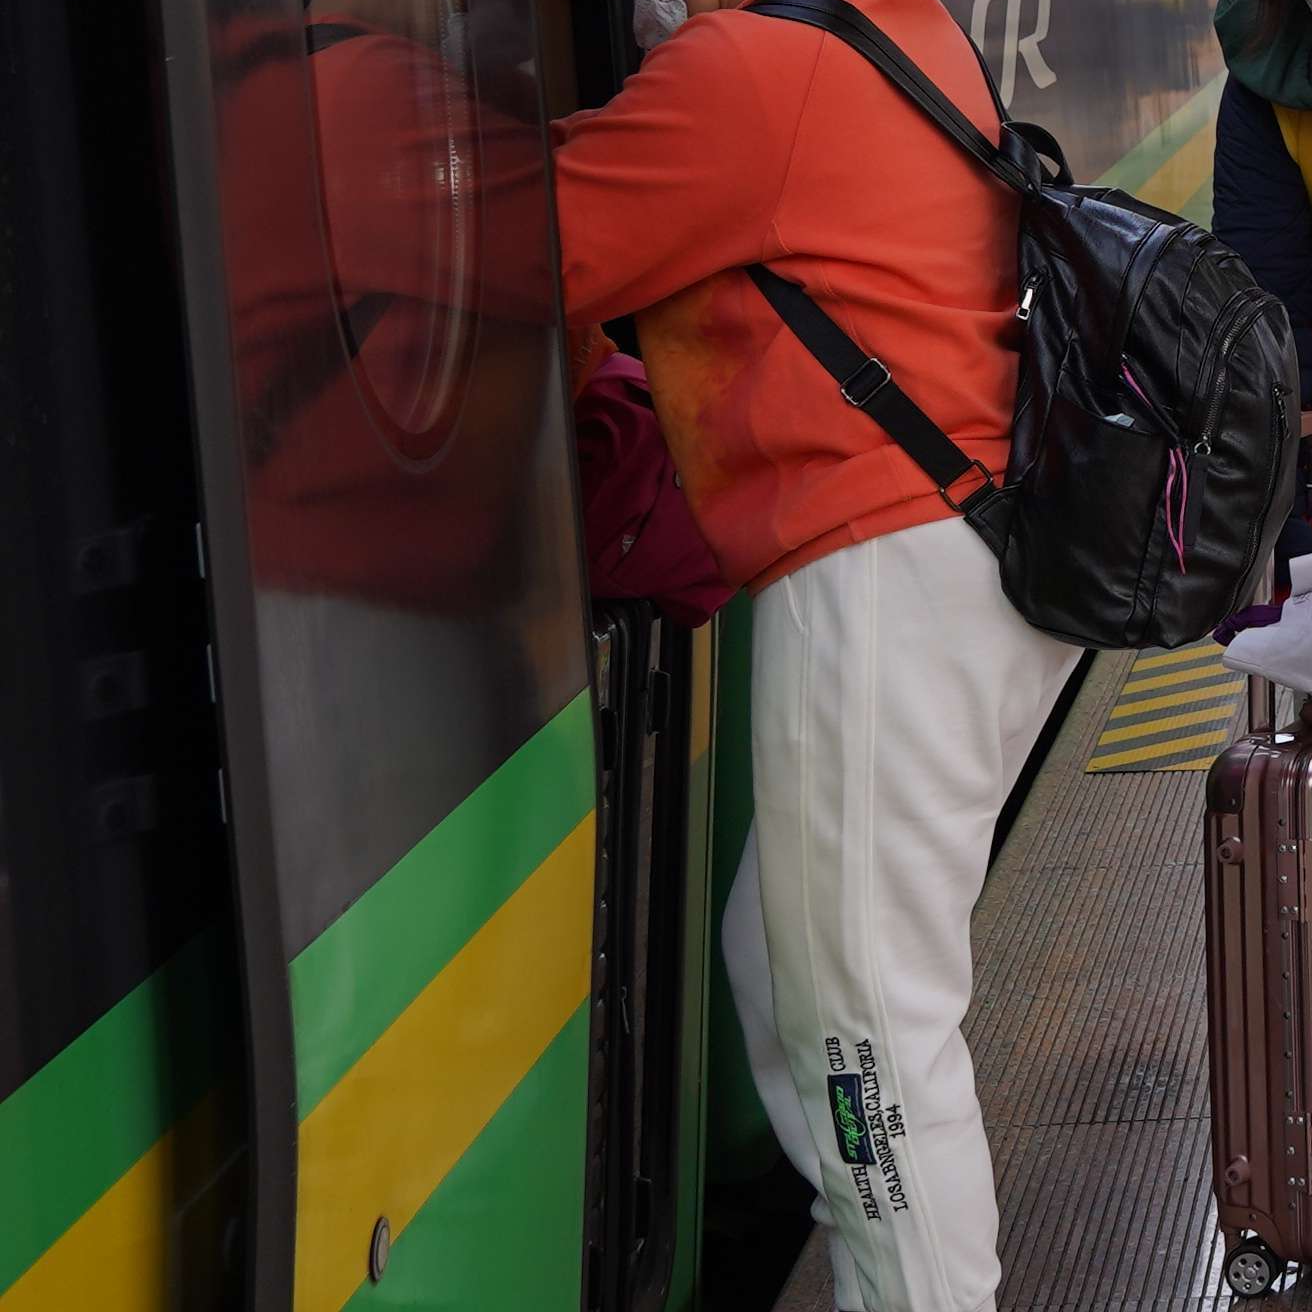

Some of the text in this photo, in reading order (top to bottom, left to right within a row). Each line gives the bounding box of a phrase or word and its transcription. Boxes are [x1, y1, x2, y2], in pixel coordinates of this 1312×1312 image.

[825, 1036, 846, 1072] CLUB
[885, 1103, 906, 1139] 1994
[851, 1163, 882, 1222] HEALTH
